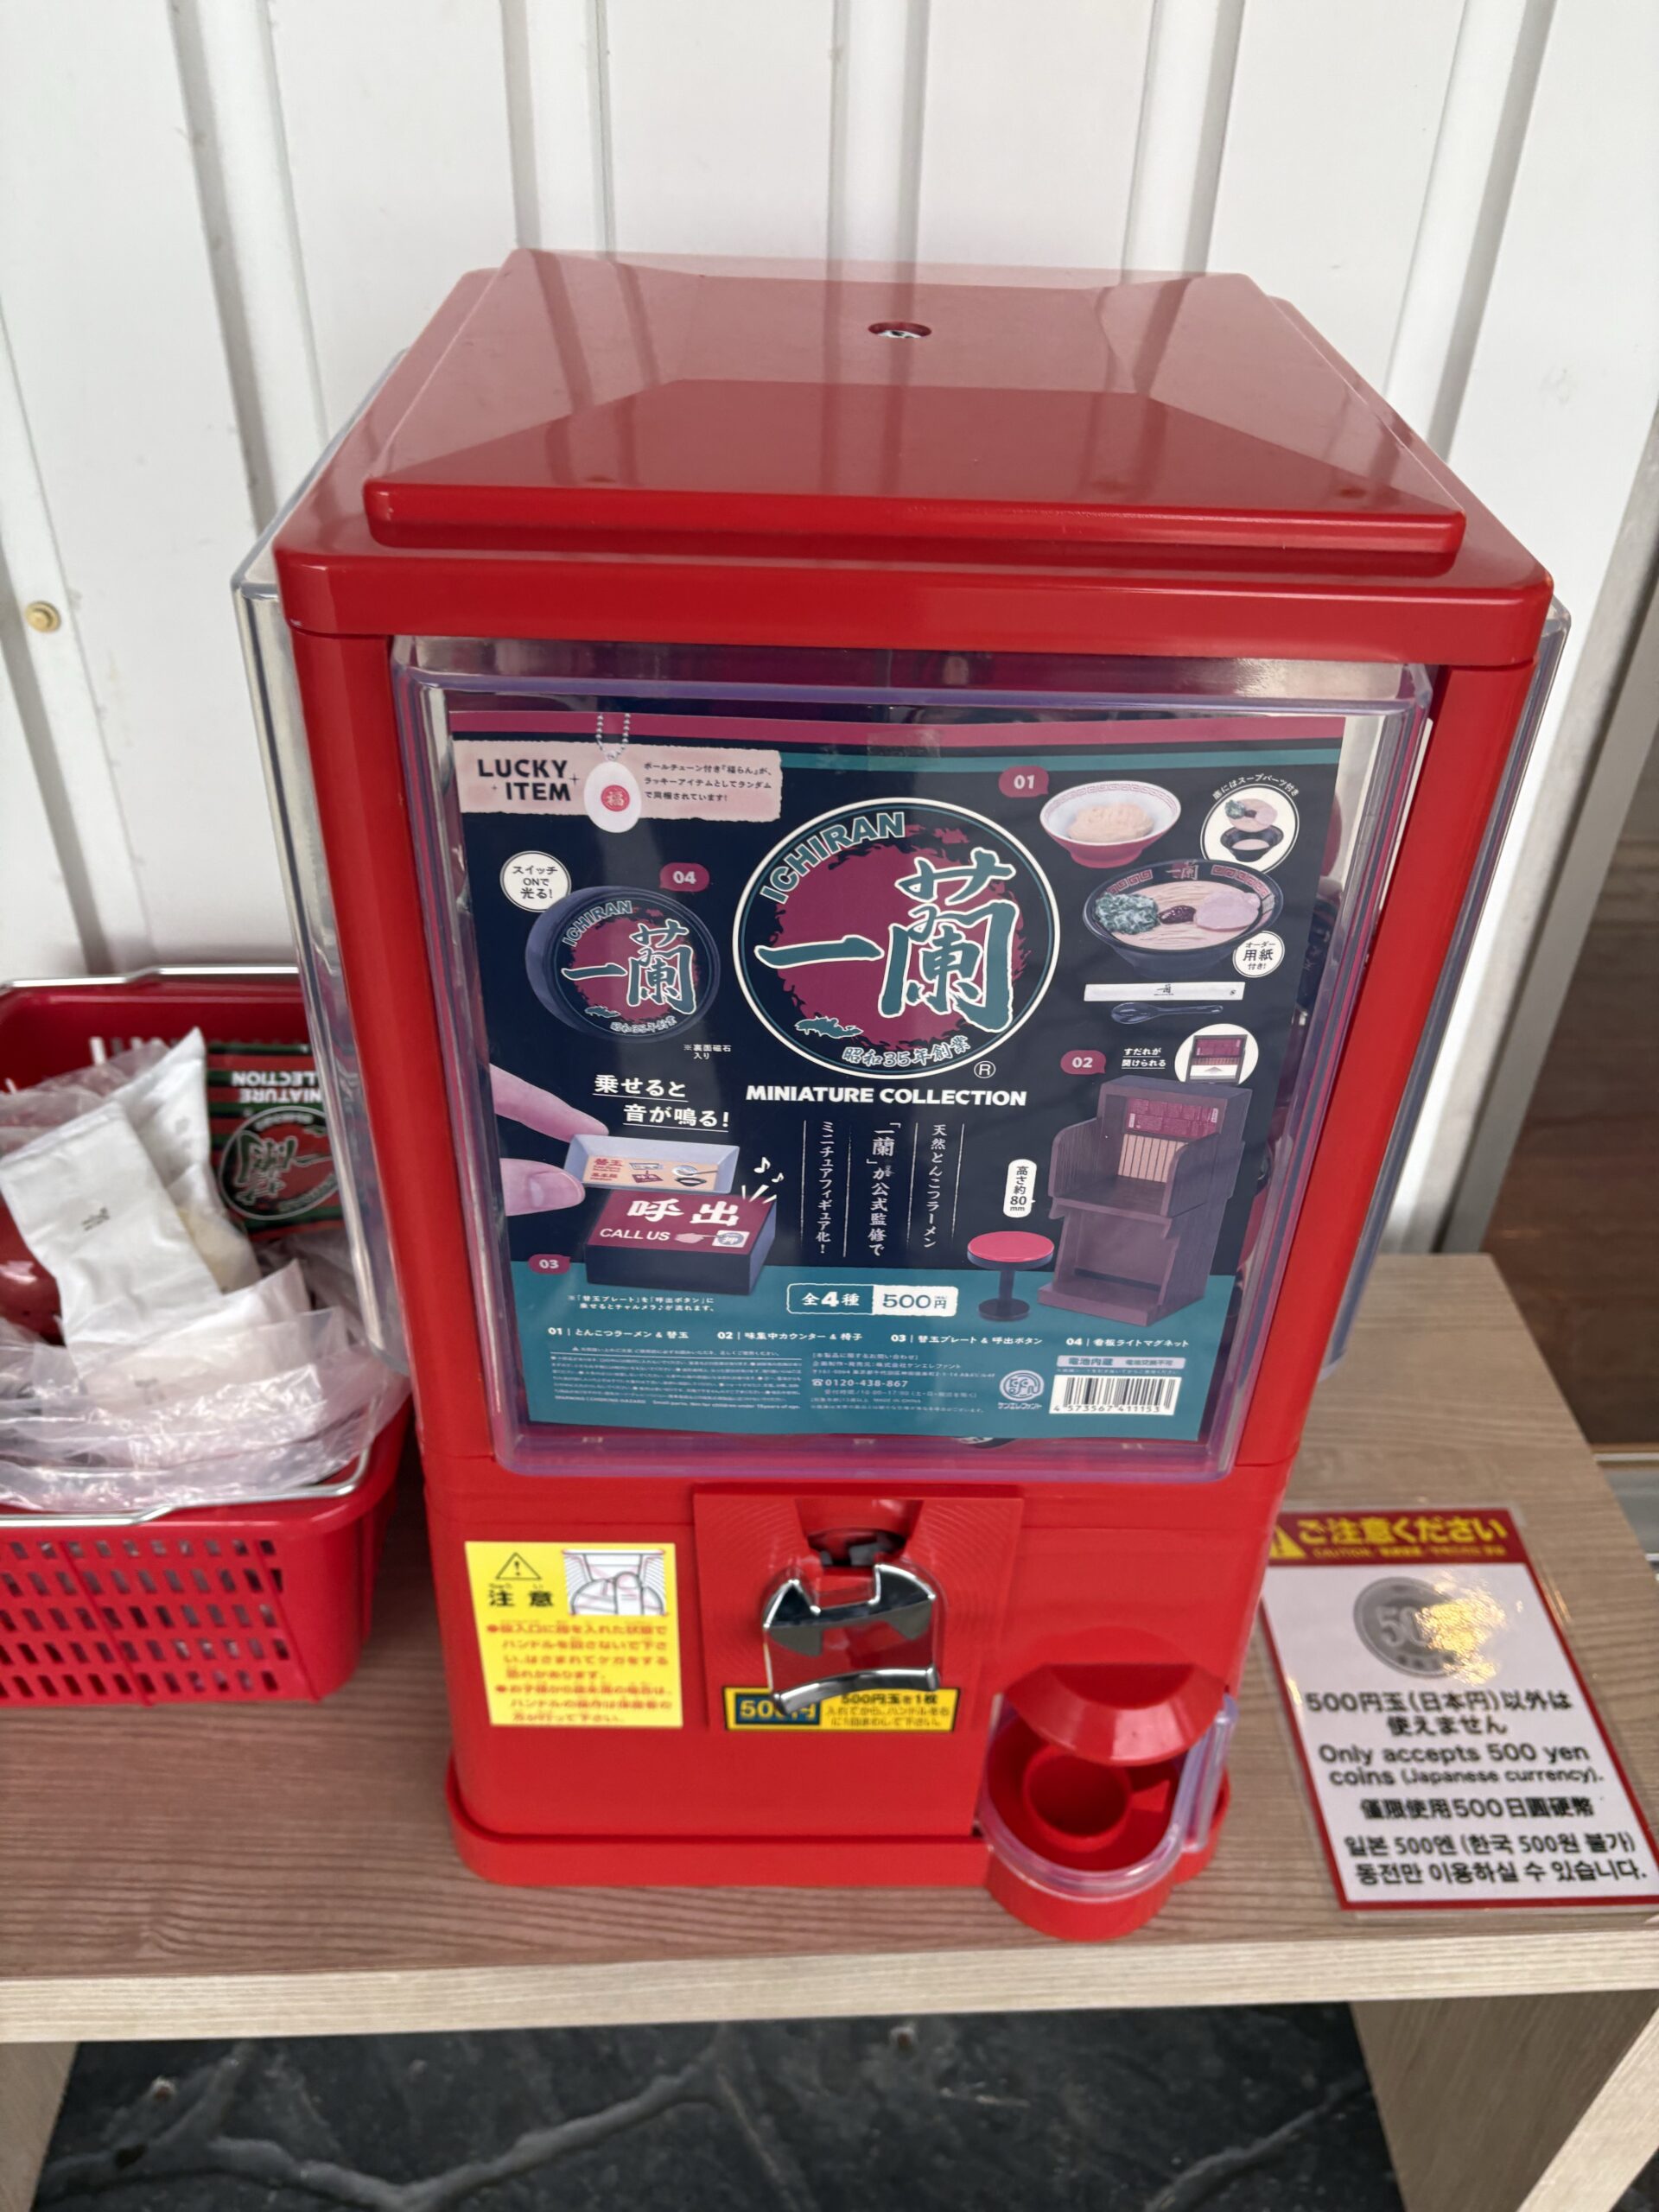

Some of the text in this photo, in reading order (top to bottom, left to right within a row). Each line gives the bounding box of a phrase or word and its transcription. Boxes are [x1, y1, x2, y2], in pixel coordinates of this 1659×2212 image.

[477, 759, 568, 778] LUCKY
[644, 777, 772, 789] ラッキーアイテムとしてランダム
[1014, 774, 1035, 789] 01
[505, 783, 571, 802] ITEM
[605, 791, 626, 808] 福
[760, 811, 906, 905] ICHIRAN
[512, 865, 559, 875] スイッチ
[672, 870, 696, 885] 04
[522, 876, 550, 887] ONで
[520, 887, 553, 900] 光る!
[562, 899, 633, 947] ICHIRAN
[753, 846, 1020, 1033] 一蘭
[1244, 940, 1276, 949] オーダー
[1243, 949, 1274, 962] 用紙
[561, 918, 696, 1015] 一蘭
[842, 1034, 971, 1068] 昭和35年創業
[1123, 1047, 1162, 1056] すだれが
[1071, 1057, 1093, 1068] 02
[1122, 1059, 1166, 1068] 開けられる
[231, 1071, 316, 1087] LECTION
[594, 1074, 687, 1097] 乗せると
[238, 1087, 322, 1103] NIATURE
[746, 1084, 1027, 1106] MINIATURE COLLECTION
[623, 1103, 729, 1128] 音が鳴る!
[923, 1123, 947, 1249] 天然とんこつラーメン
[1012, 1166, 1028, 1195] 高さ約
[1009, 1196, 1027, 1206] 80
[627, 1198, 740, 1227] 呼出
[600, 1228, 671, 1241] CALL US
[539, 1259, 559, 1269] 03
[801, 1291, 861, 1308] 全4種
[882, 1294, 947, 1310] 500円
[547, 1327, 563, 1336] 01
[575, 1328, 652, 1338] とんこつラーメン
[744, 1332, 826, 1341] 味集中カウンター
[891, 1334, 906, 1343] 03
[1065, 1338, 1083, 1346] 04
[824, 1379, 908, 1388] 0120-438-867
[1068, 1404, 1114, 1413] 573567
[1118, 1405, 1160, 1414] 411153
[1298, 1516, 1509, 1545] ご注意ください
[487, 1589, 554, 1608] 注意
[1305, 1689, 1573, 1713] 500円玉(日本円)以外は
[1319, 1743, 1590, 1766] Only accepts 500 yen
[1329, 1765, 1605, 1786] coins (Japanese currency).
[1344, 1831, 1636, 1858] 일본 500엔 (한국 500원 불가)
[1355, 1858, 1648, 1885] 동전만 이용하실 수 있습니다.
